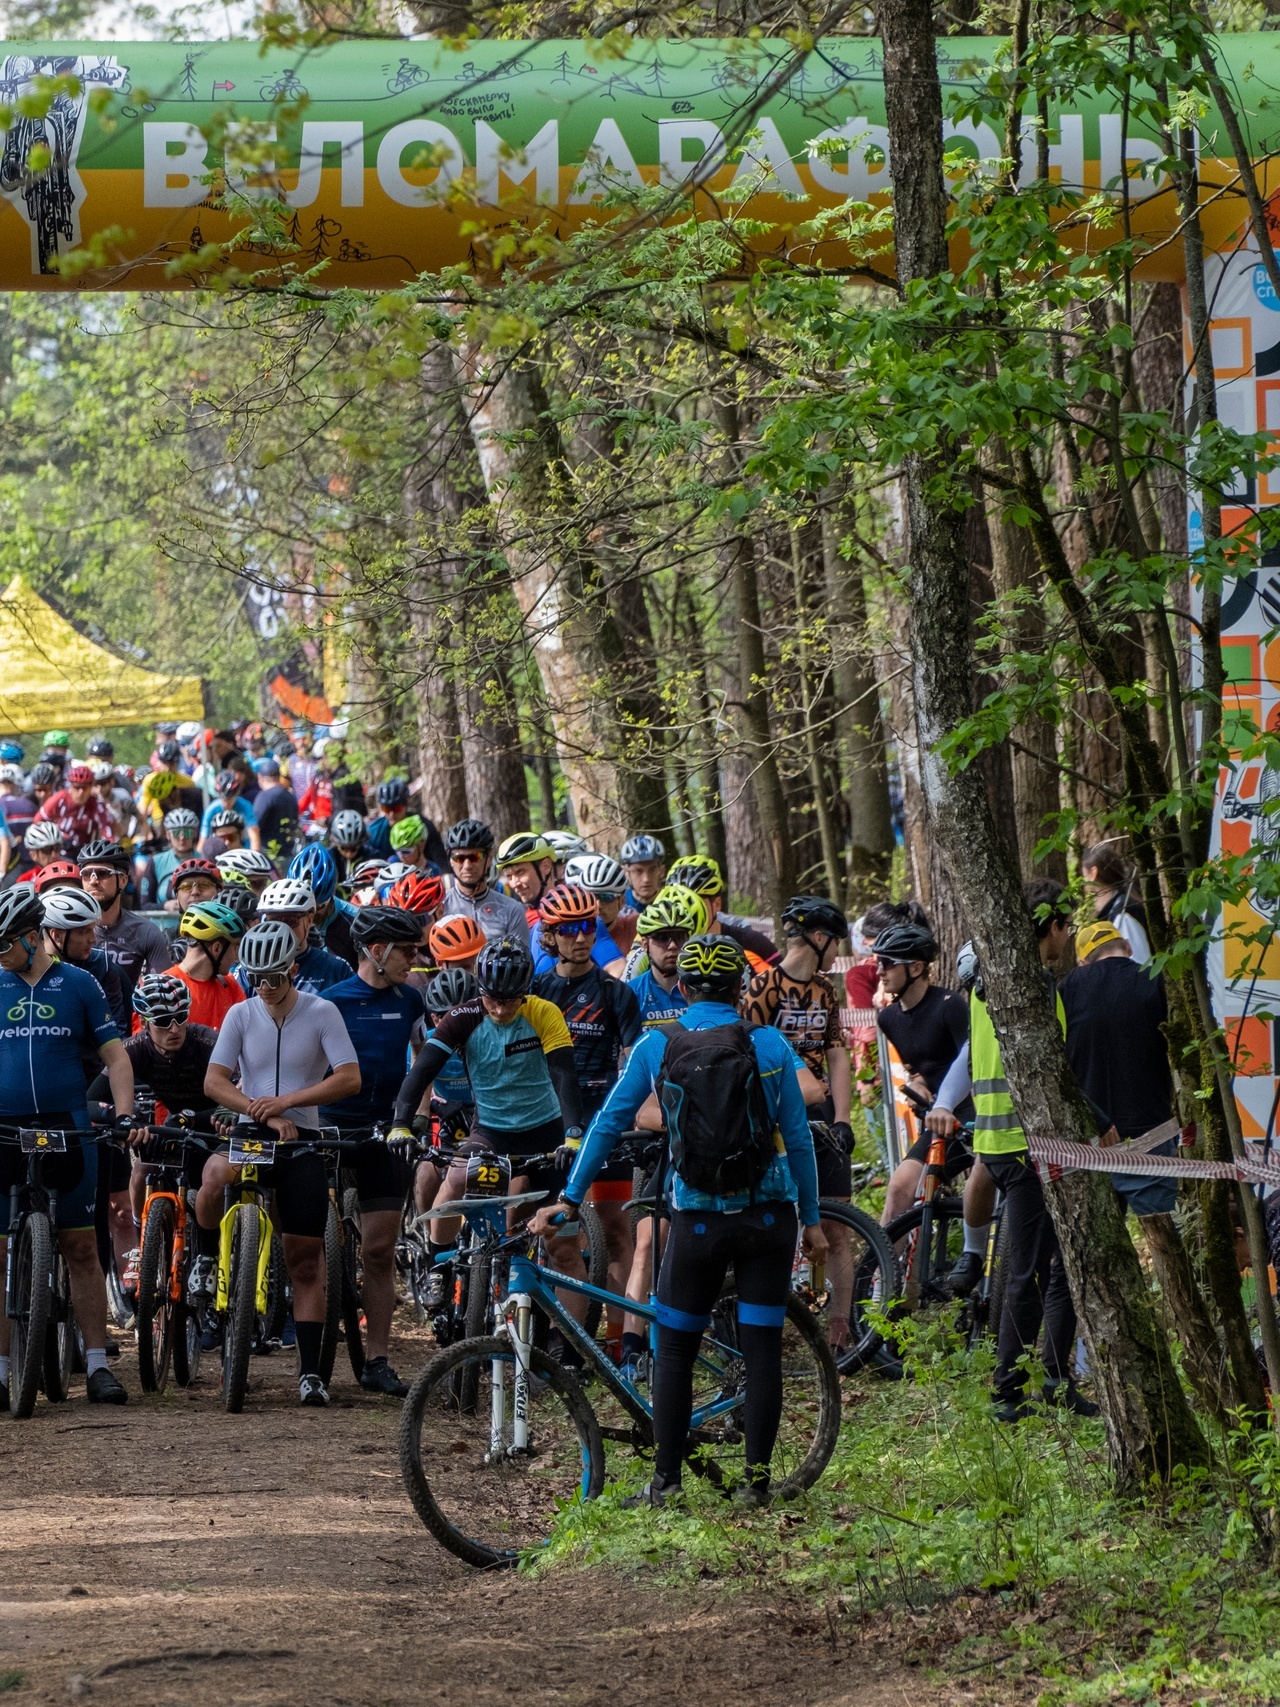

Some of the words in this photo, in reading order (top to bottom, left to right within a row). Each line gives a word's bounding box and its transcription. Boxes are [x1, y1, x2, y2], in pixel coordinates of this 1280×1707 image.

[567, 1021, 606, 1031] IBERIA
[780, 1015, 826, 1028] PBO
[242, 1142, 263, 1152] 14
[477, 1166, 500, 1183] 25
